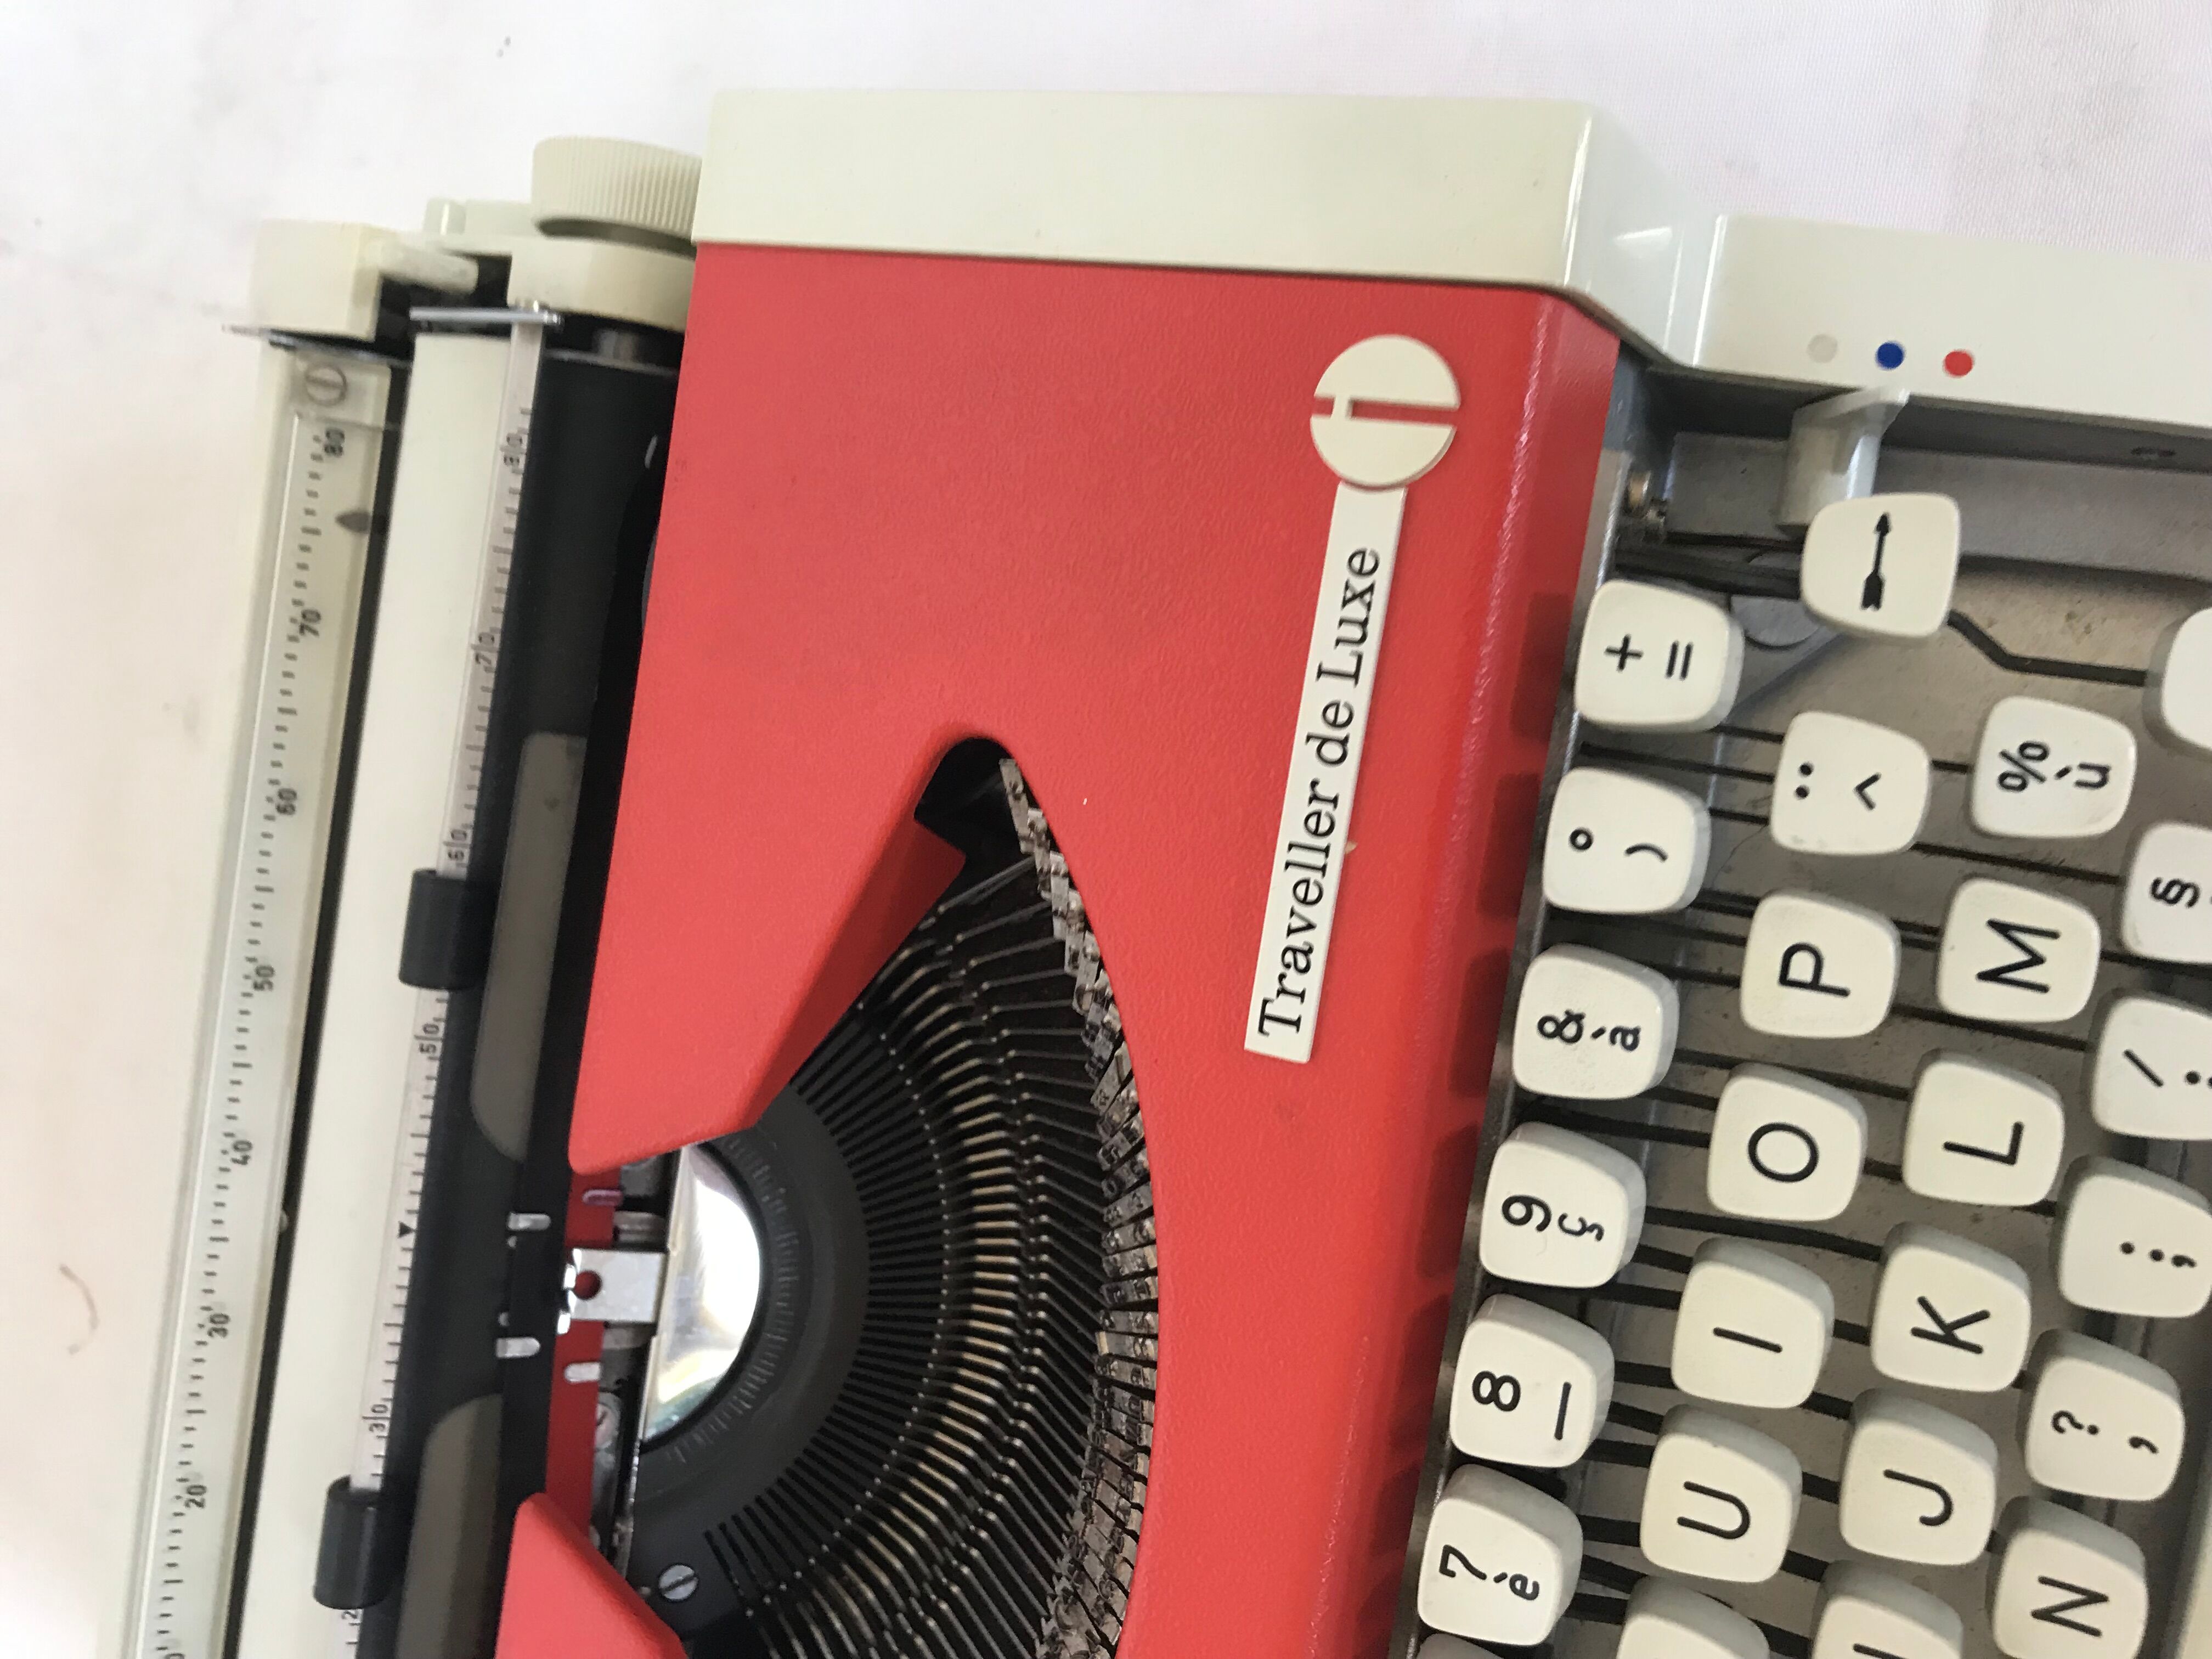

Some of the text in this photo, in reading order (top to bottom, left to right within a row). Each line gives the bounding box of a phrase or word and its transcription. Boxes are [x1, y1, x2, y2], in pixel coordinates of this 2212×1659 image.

[1606, 635, 1641, 670] +
[1666, 642, 1692, 679] =
[1998, 742, 2050, 792] %
[1257, 546, 1380, 1036] Traveller de Luxe
[1626, 844, 1667, 861] )
[2151, 878, 2199, 907] §
[1779, 943, 1849, 997] P
[1977, 919, 2060, 993] M
[1537, 1010, 1585, 1044] &
[184, 1484, 207, 1509] 20
[207, 1312, 230, 1339] 30
[231, 1139, 253, 1166] 40
[253, 964, 275, 992] 50
[275, 787, 298, 816] 60
[298, 609, 322, 636] 70
[1748, 1124, 1819, 1182] O
[1944, 1122, 2024, 1165] L
[1502, 1195, 1551, 1232] 9
[1558, 1214, 1604, 1241] ç
[1713, 1328, 1782, 1353] I
[1911, 1297, 1989, 1354] K
[1472, 1372, 1520, 1412] 8
[2052, 1411, 2098, 1435] ?
[1677, 1482, 1750, 1539] U
[1884, 1470, 1953, 1526] J
[1439, 1545, 1487, 1580] 7
[1494, 1573, 1539, 1600] è
[2032, 1577, 2108, 1637] N
